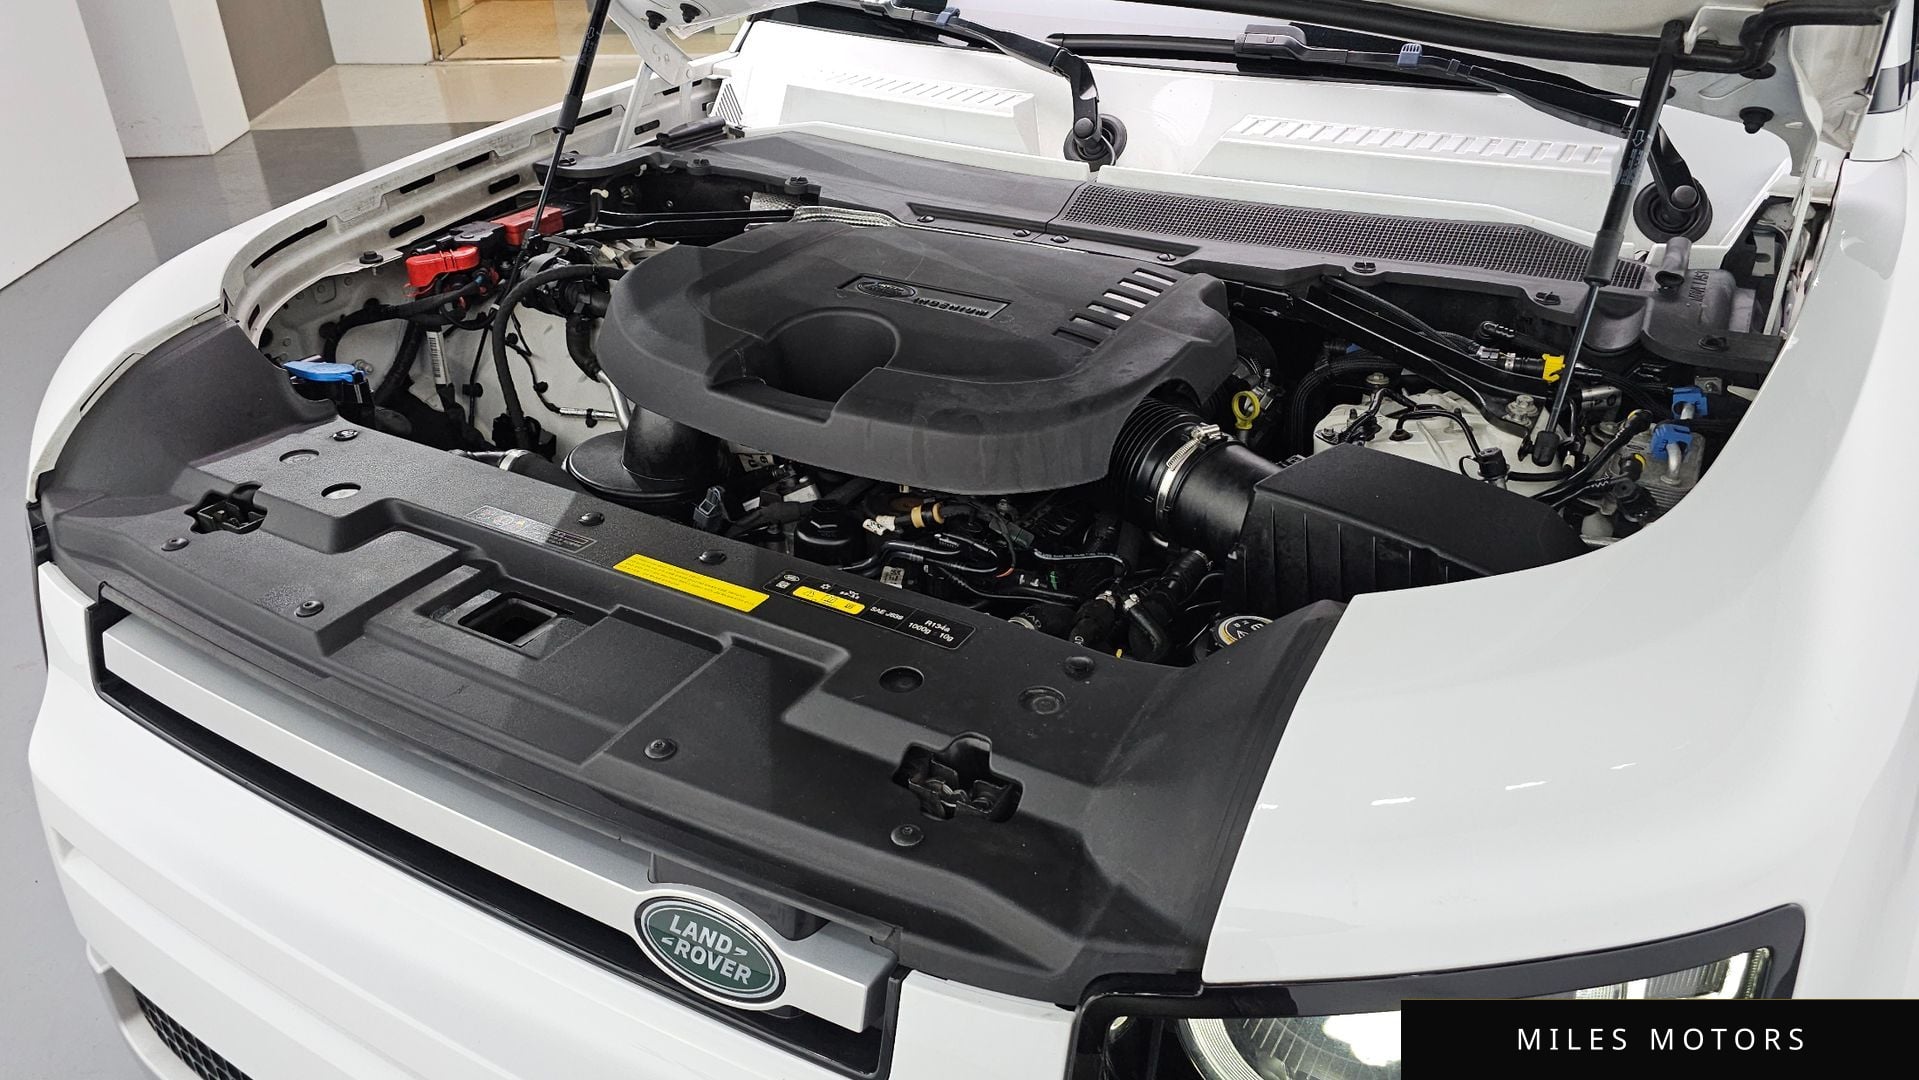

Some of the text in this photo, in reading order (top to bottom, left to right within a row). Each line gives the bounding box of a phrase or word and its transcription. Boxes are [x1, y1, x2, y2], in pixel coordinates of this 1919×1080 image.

[870, 606, 886, 616] SAE
[908, 622, 955, 642] 1000g 10g
[924, 620, 951, 633] R134a
[669, 914, 733, 955] LAND
[673, 937, 752, 986] ROVER
